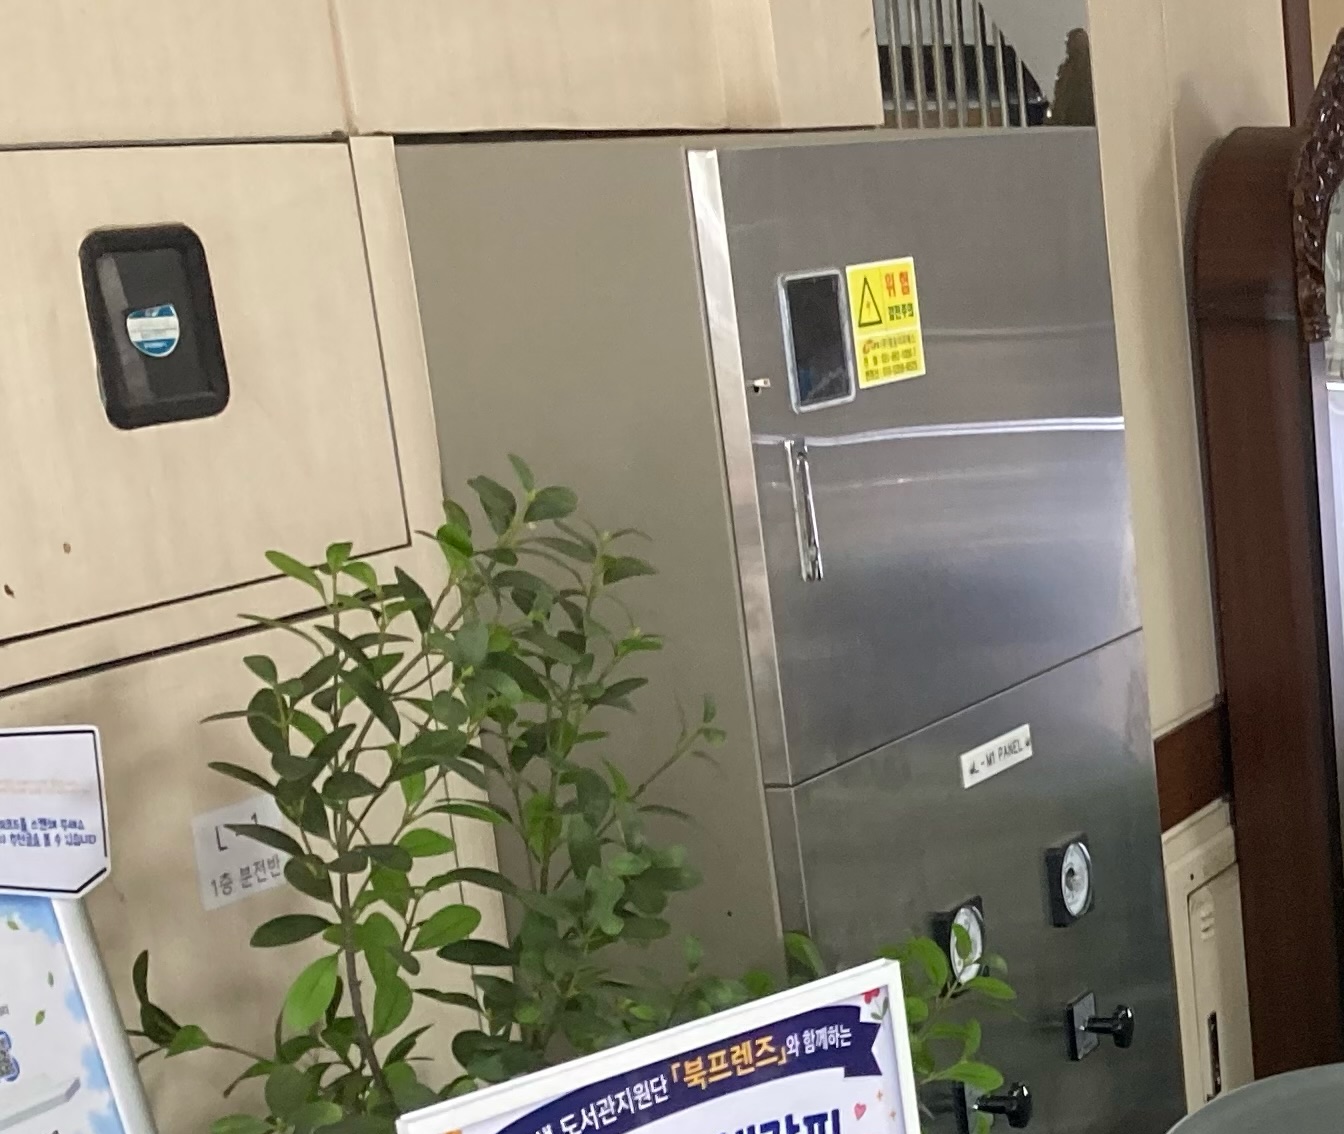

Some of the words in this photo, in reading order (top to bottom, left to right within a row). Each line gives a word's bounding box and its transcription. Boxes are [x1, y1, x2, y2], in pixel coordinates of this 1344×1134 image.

[998, 739, 1023, 761] PANEL
[211, 873, 233, 897] 1층
[239, 854, 281, 889] 분전반
[801, 1024, 852, 1058] 함께하는
